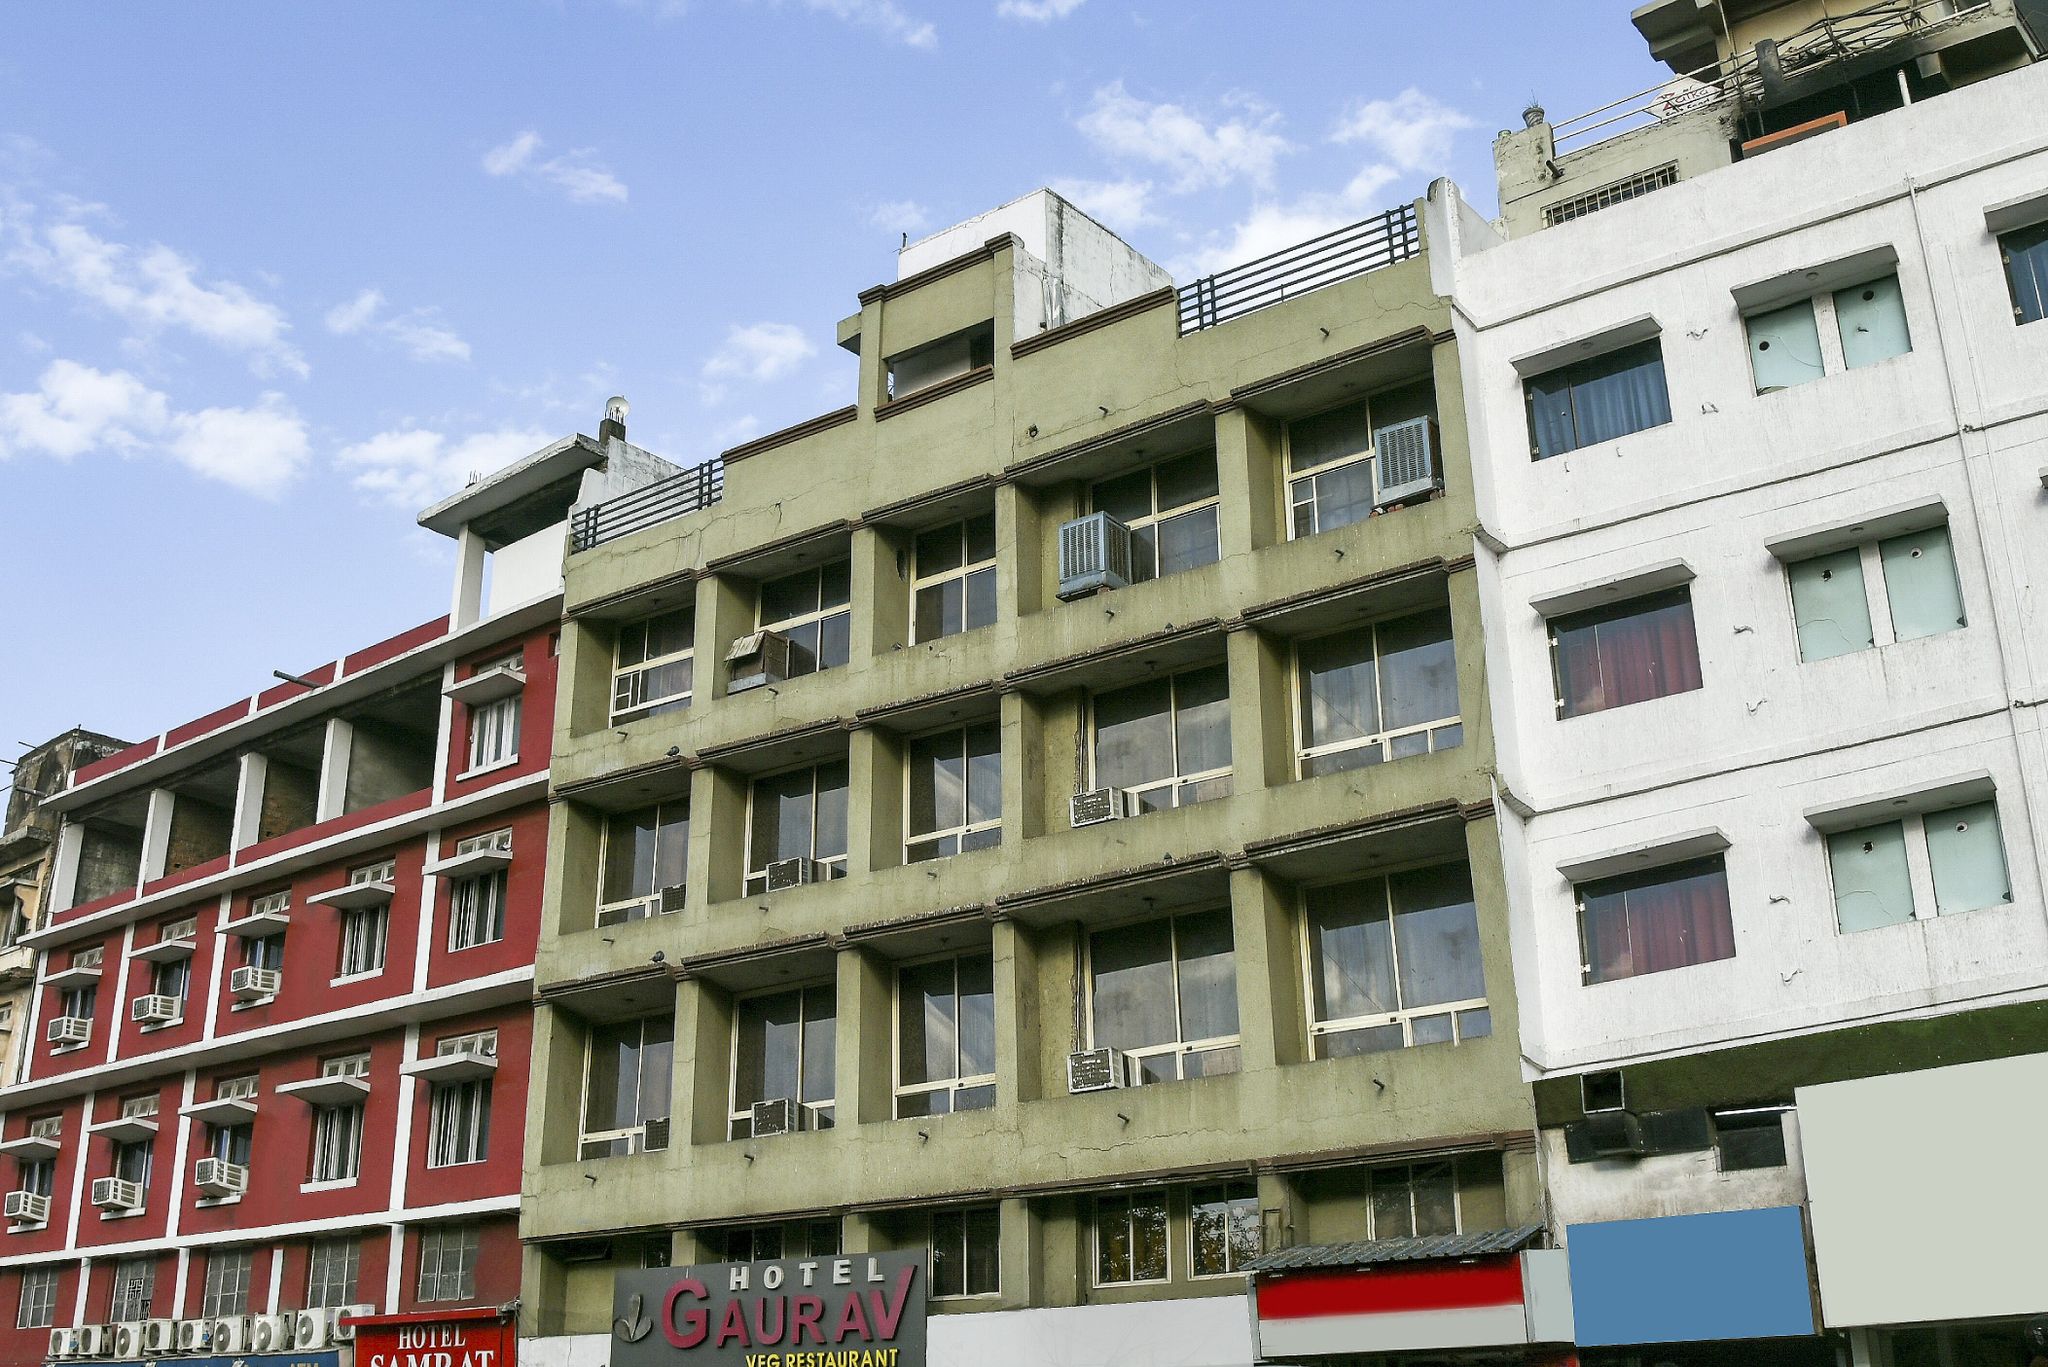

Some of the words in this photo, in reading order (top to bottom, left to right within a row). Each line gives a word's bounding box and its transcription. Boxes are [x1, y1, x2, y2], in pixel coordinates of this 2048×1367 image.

[729, 1257, 885, 1291] HOTEL
[662, 1264, 918, 1349] GAURAV
[397, 1324, 466, 1350] HOTEL
[785, 1348, 898, 1367] RESTAURANT
